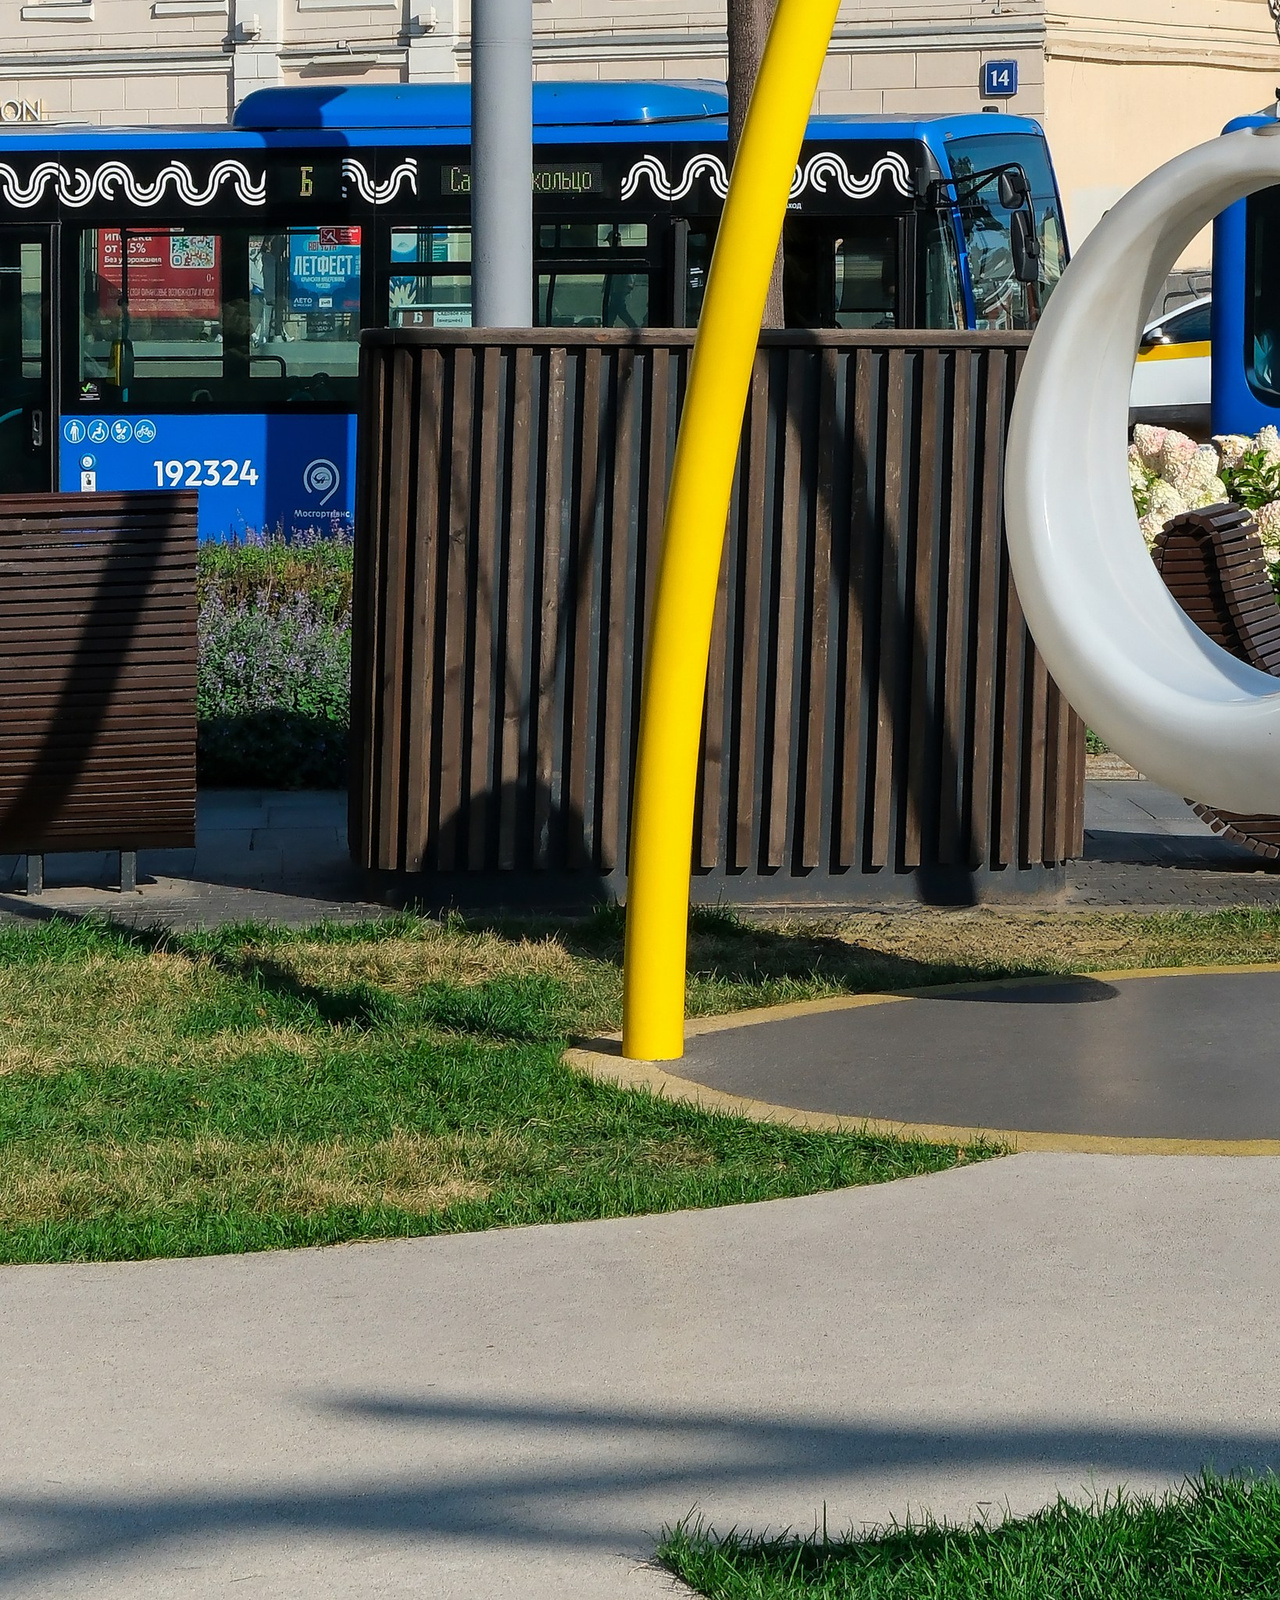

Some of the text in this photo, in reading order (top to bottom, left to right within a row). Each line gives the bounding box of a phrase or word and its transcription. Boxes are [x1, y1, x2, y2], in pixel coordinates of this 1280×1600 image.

[990, 69, 1010, 87] 14
[300, 166, 313, 196] Б
[104, 245, 118, 253] от
[293, 255, 353, 276] ЛЕТФЕСТ
[154, 460, 259, 487] 192324
